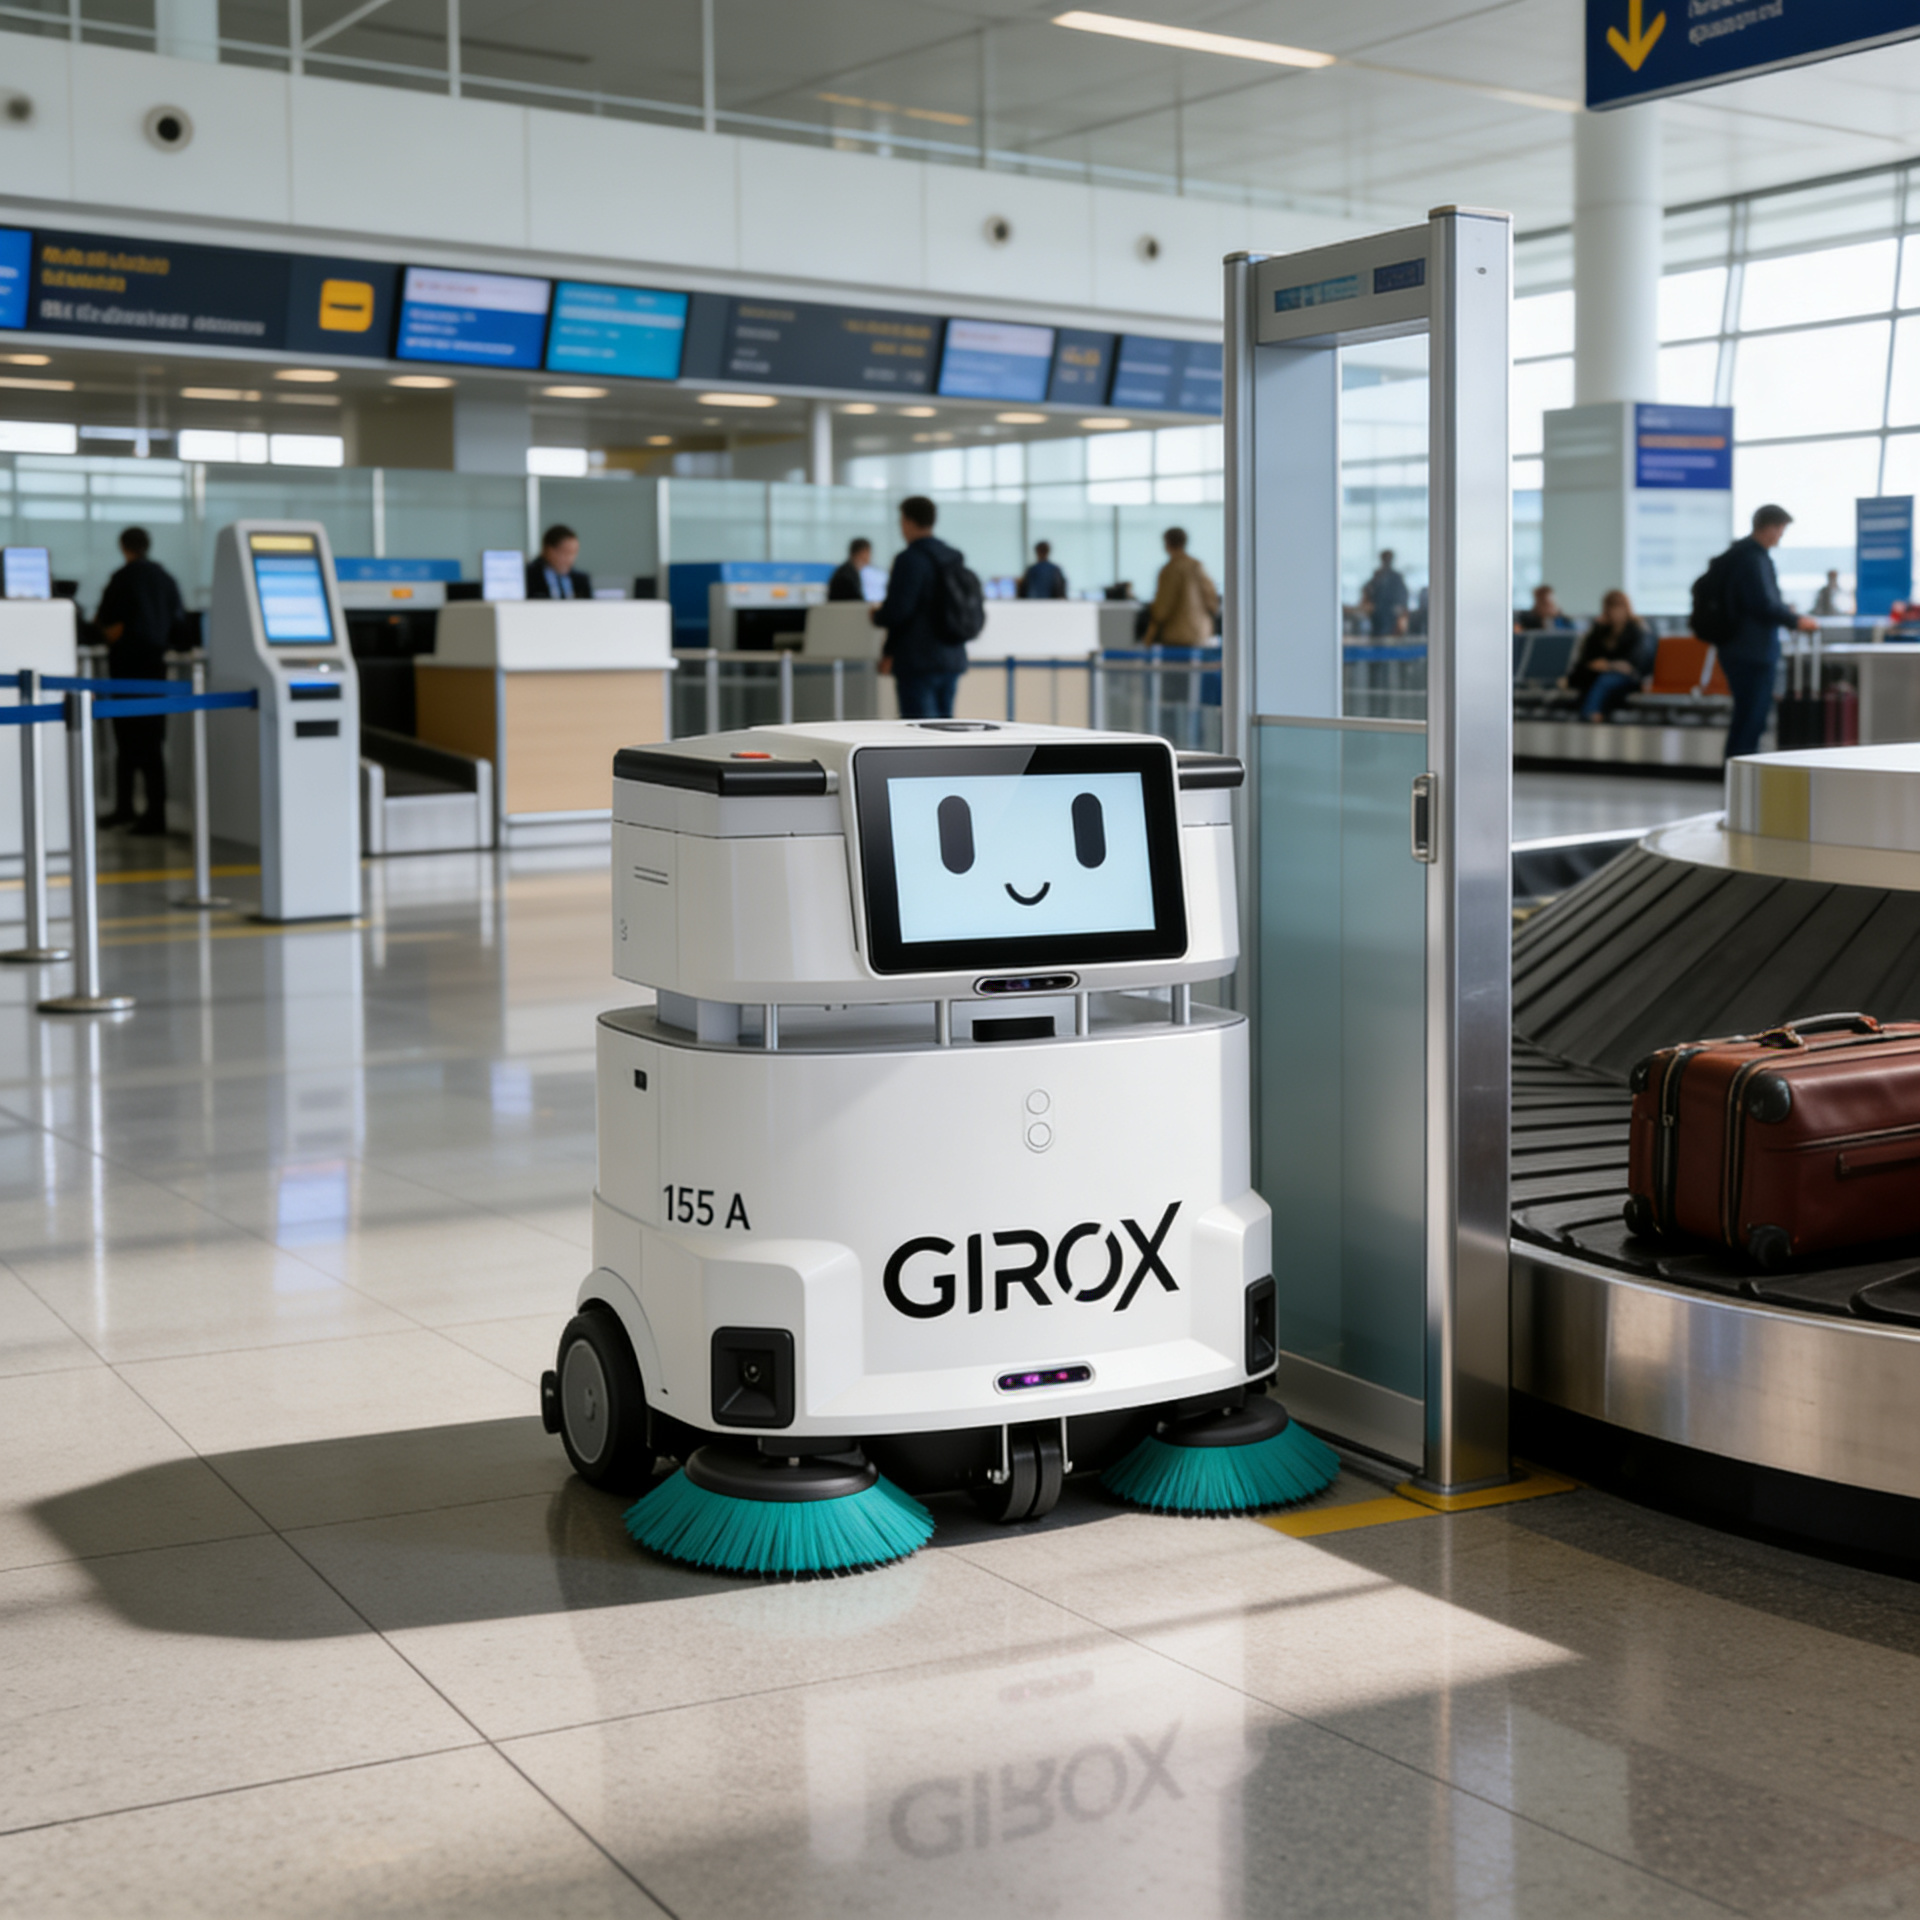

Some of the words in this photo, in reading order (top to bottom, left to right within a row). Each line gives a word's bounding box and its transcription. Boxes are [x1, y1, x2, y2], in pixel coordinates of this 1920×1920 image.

[663, 1184, 714, 1227] 155
[724, 1193, 751, 1231] A
[883, 1201, 1182, 1319] GIROX
